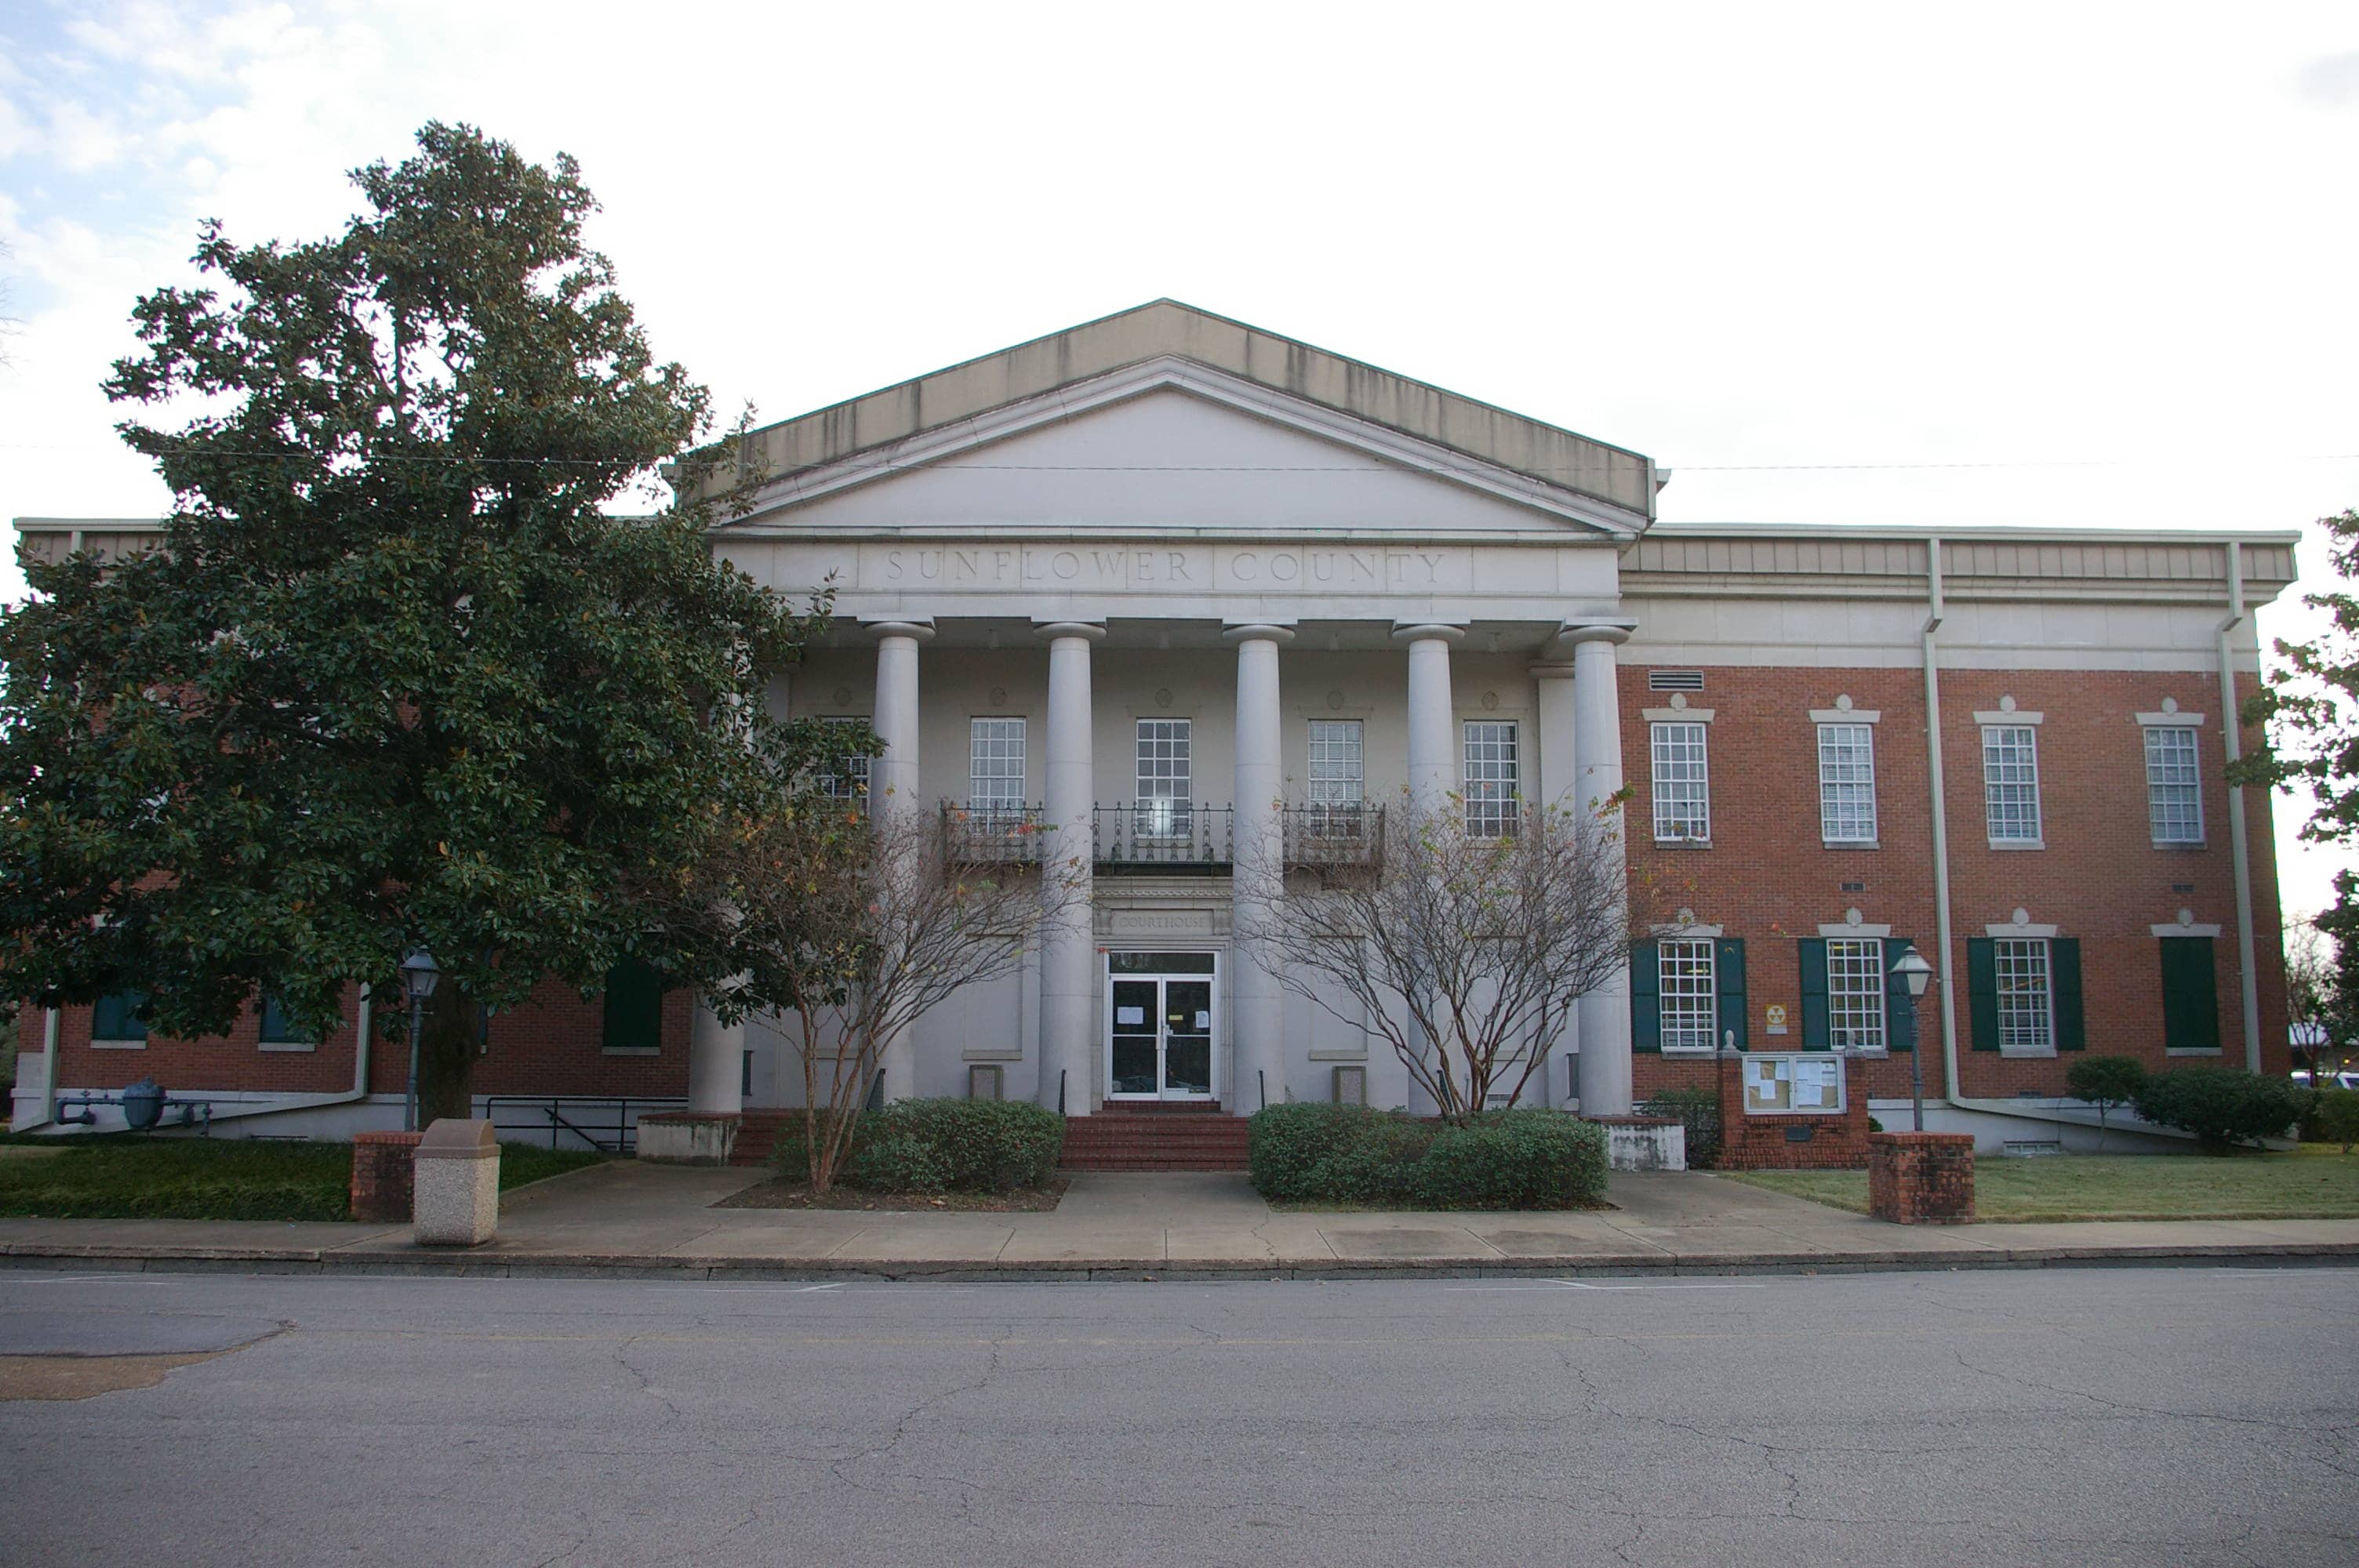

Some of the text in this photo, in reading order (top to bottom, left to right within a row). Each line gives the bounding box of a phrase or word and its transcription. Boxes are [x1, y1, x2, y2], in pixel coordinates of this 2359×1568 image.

[887, 551, 1445, 583] SUNFLOWER COUNTY
[1119, 916, 1205, 929] COURTHOUSE
